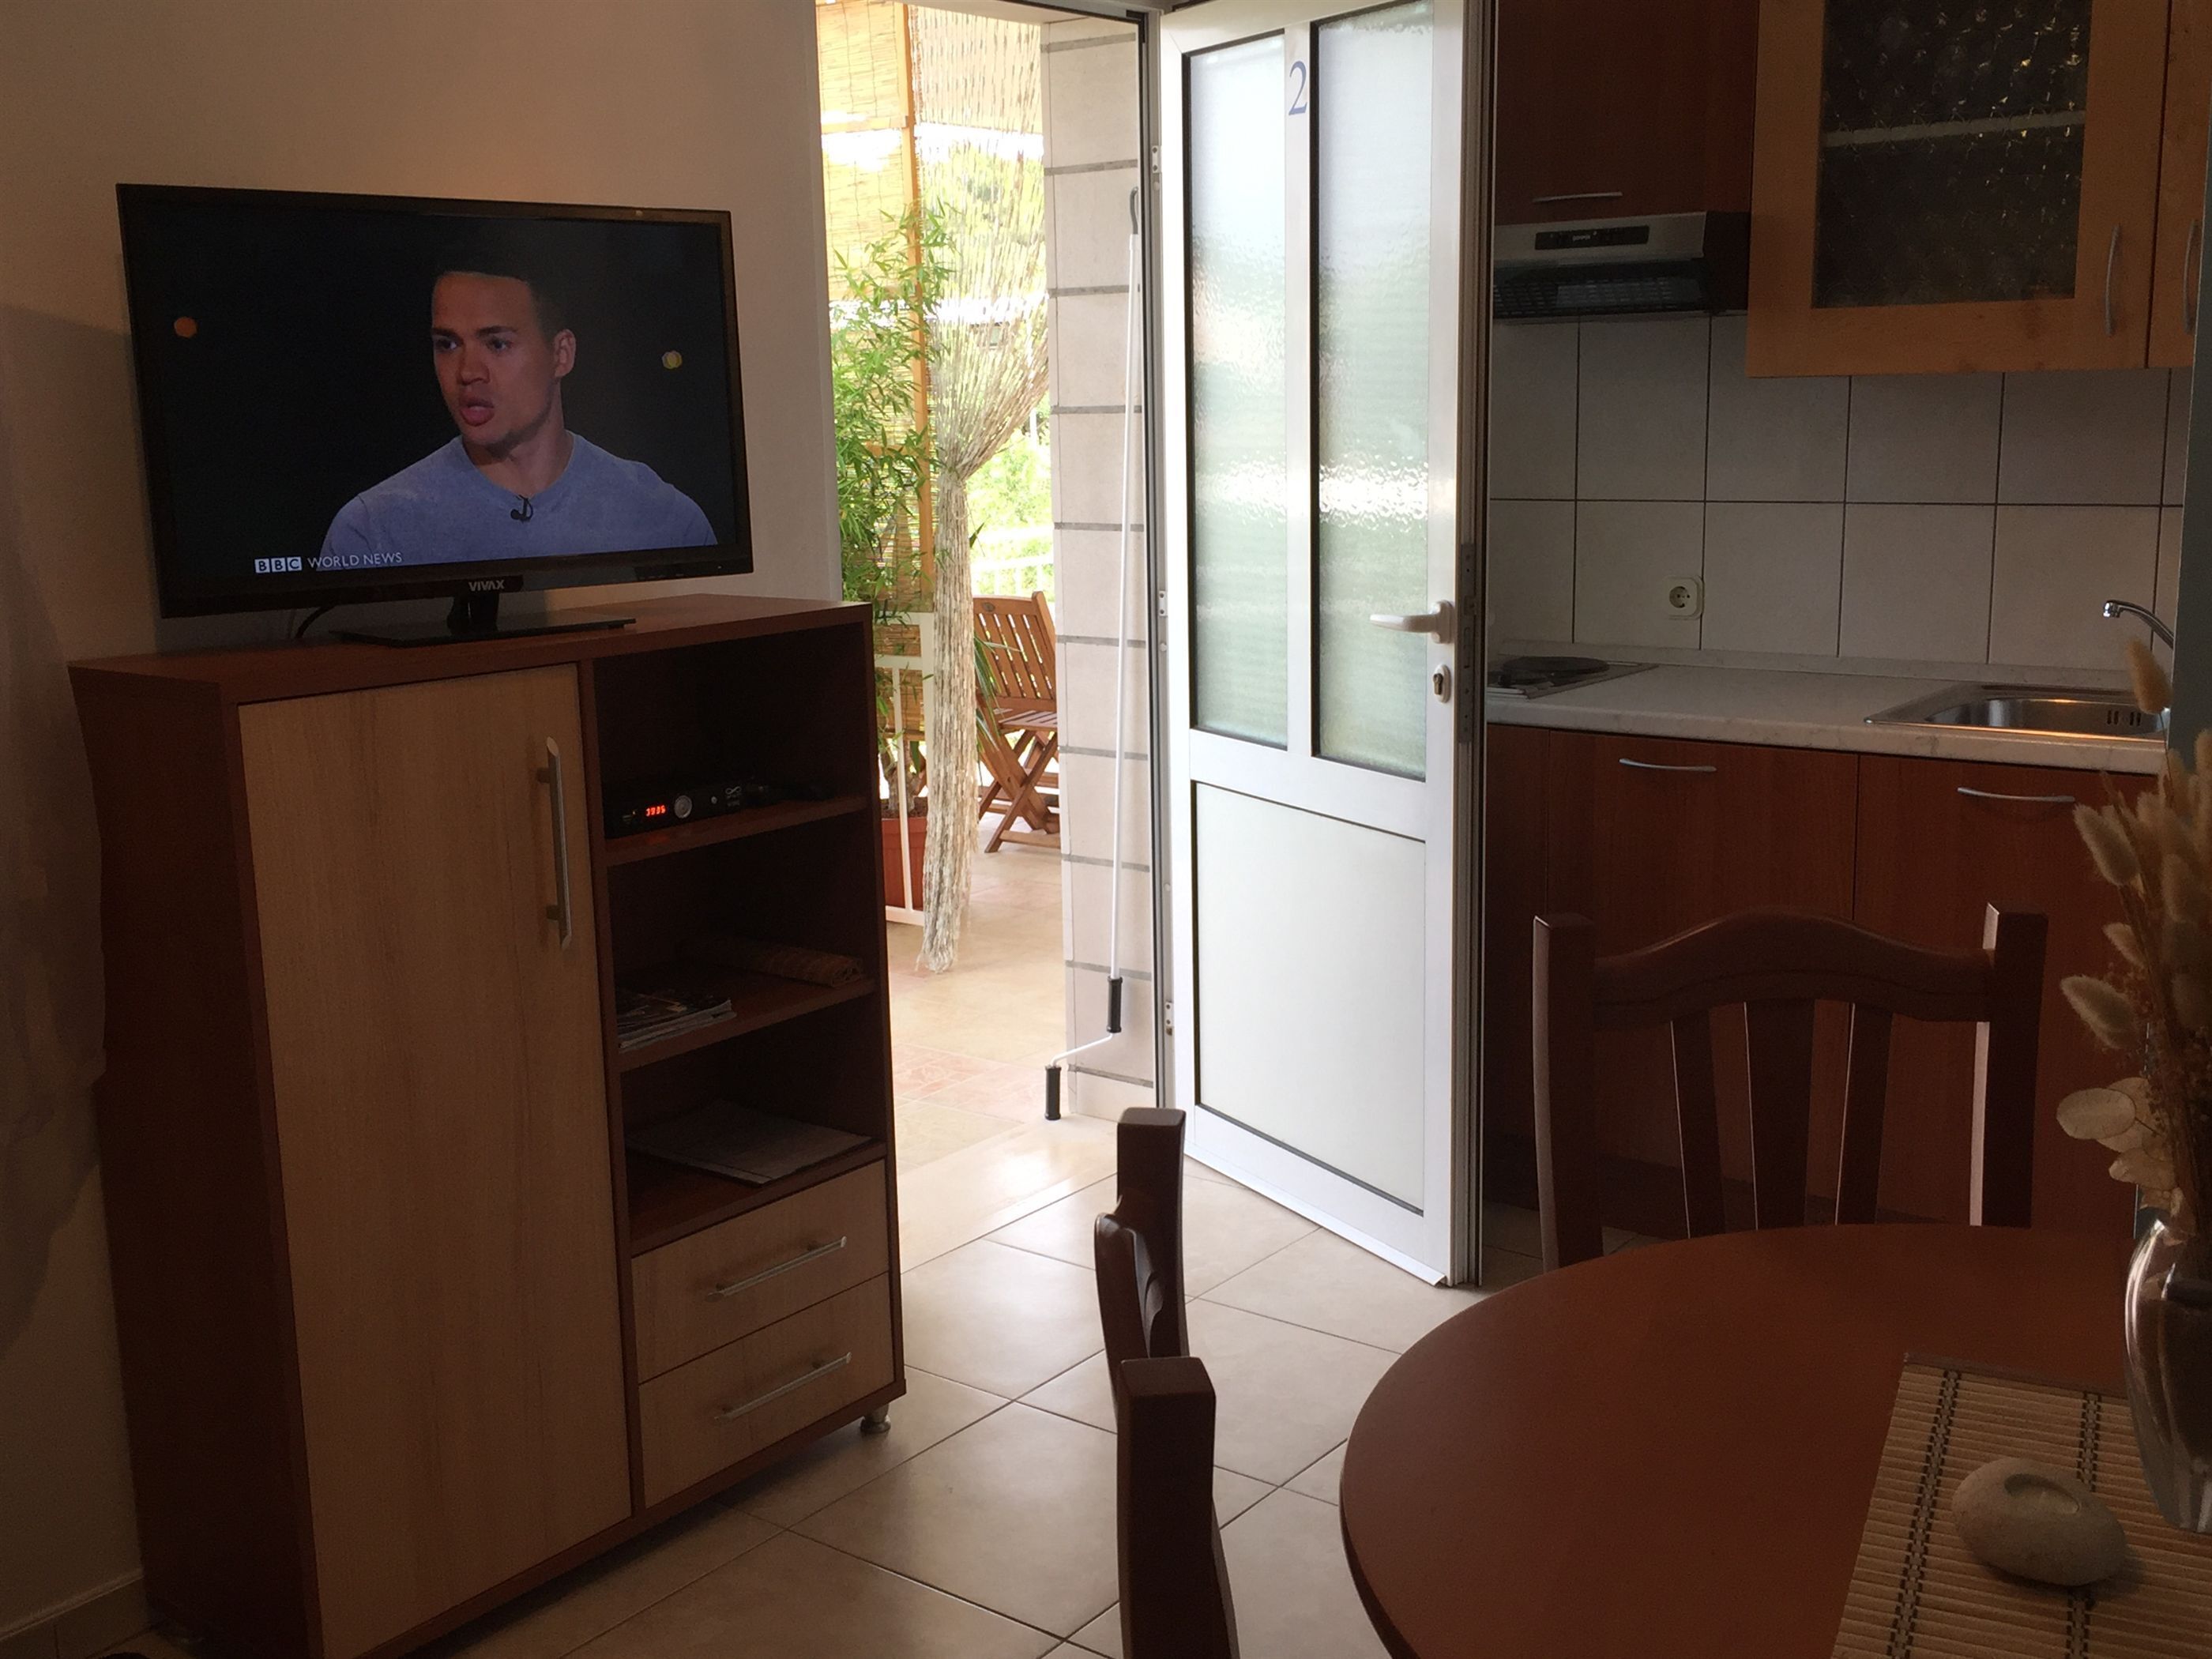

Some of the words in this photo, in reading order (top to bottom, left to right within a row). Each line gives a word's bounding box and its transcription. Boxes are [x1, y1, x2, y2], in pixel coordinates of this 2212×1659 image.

[1288, 60, 1307, 115] 2
[254, 557, 303, 574] BBC
[307, 555, 359, 568] WORLD
[363, 552, 402, 565] NEWS
[468, 579, 505, 592] VIVAX
